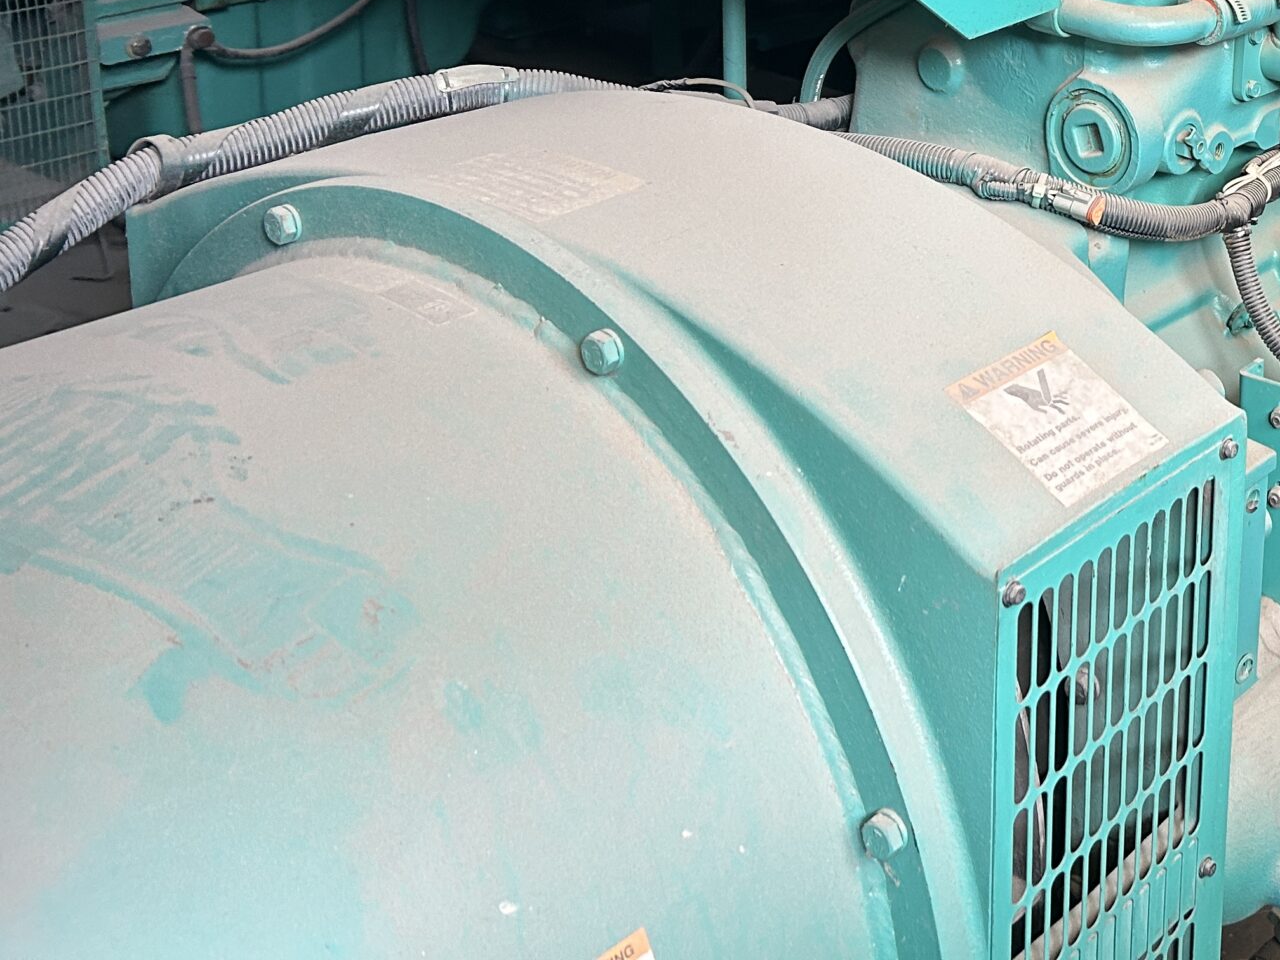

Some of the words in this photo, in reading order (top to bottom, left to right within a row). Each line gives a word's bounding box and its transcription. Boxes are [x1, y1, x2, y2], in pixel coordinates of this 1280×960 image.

[973, 339, 1058, 386] WARNING
[1015, 428, 1056, 454] Rotating
[1054, 416, 1081, 433] parts.
[1030, 453, 1049, 467] Can
[1049, 437, 1076, 456] cause
[1076, 420, 1104, 440] severe
[1103, 407, 1129, 425] injury.
[1043, 470, 1058, 482] Do
[1058, 459, 1075, 473] not
[1074, 440, 1107, 464] operate
[1107, 422, 1138, 443] without
[1055, 469, 1085, 492] guards
[1085, 462, 1096, 473] in
[1094, 448, 1121, 468] place.
